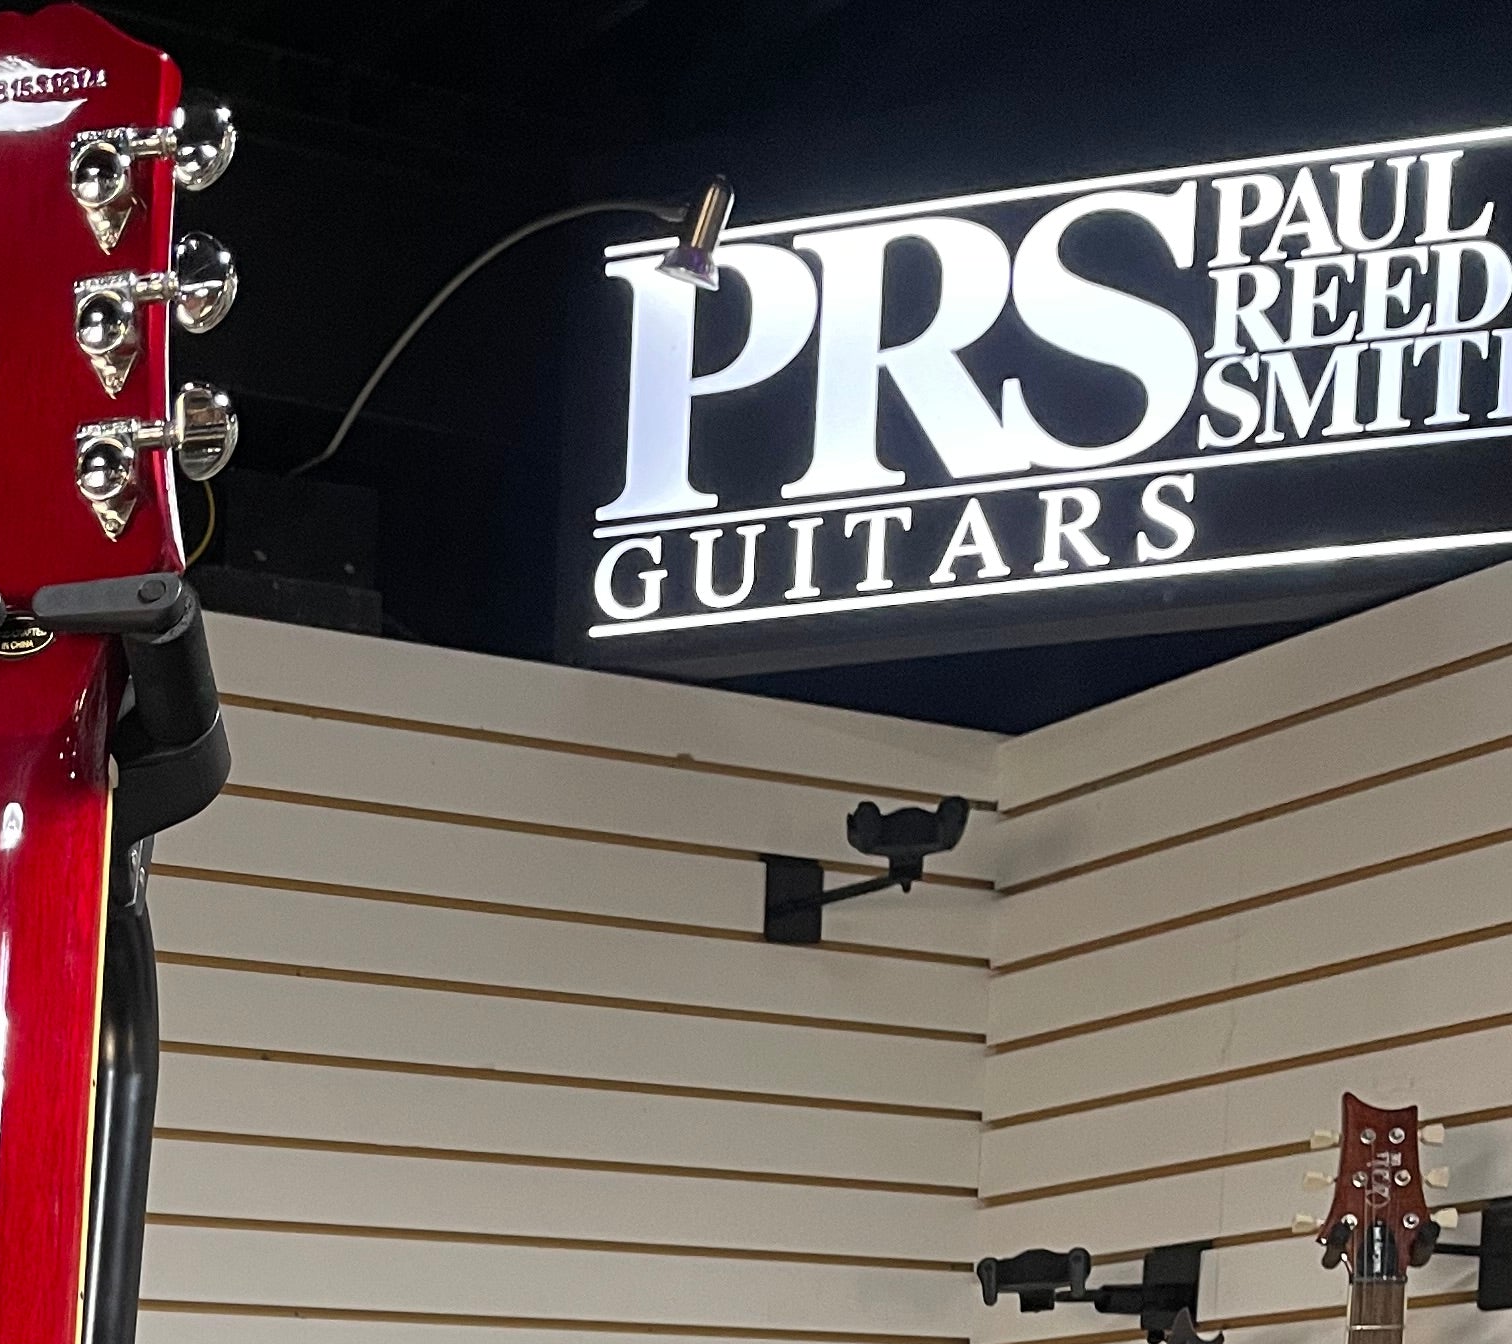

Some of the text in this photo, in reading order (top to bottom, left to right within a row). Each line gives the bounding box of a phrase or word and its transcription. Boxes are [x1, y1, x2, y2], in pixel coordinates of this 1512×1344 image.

[1208, 150, 1494, 269] PAUL
[596, 181, 1199, 522] PRS
[1204, 239, 1512, 359] REED
[593, 473, 1195, 621] GUITARS
